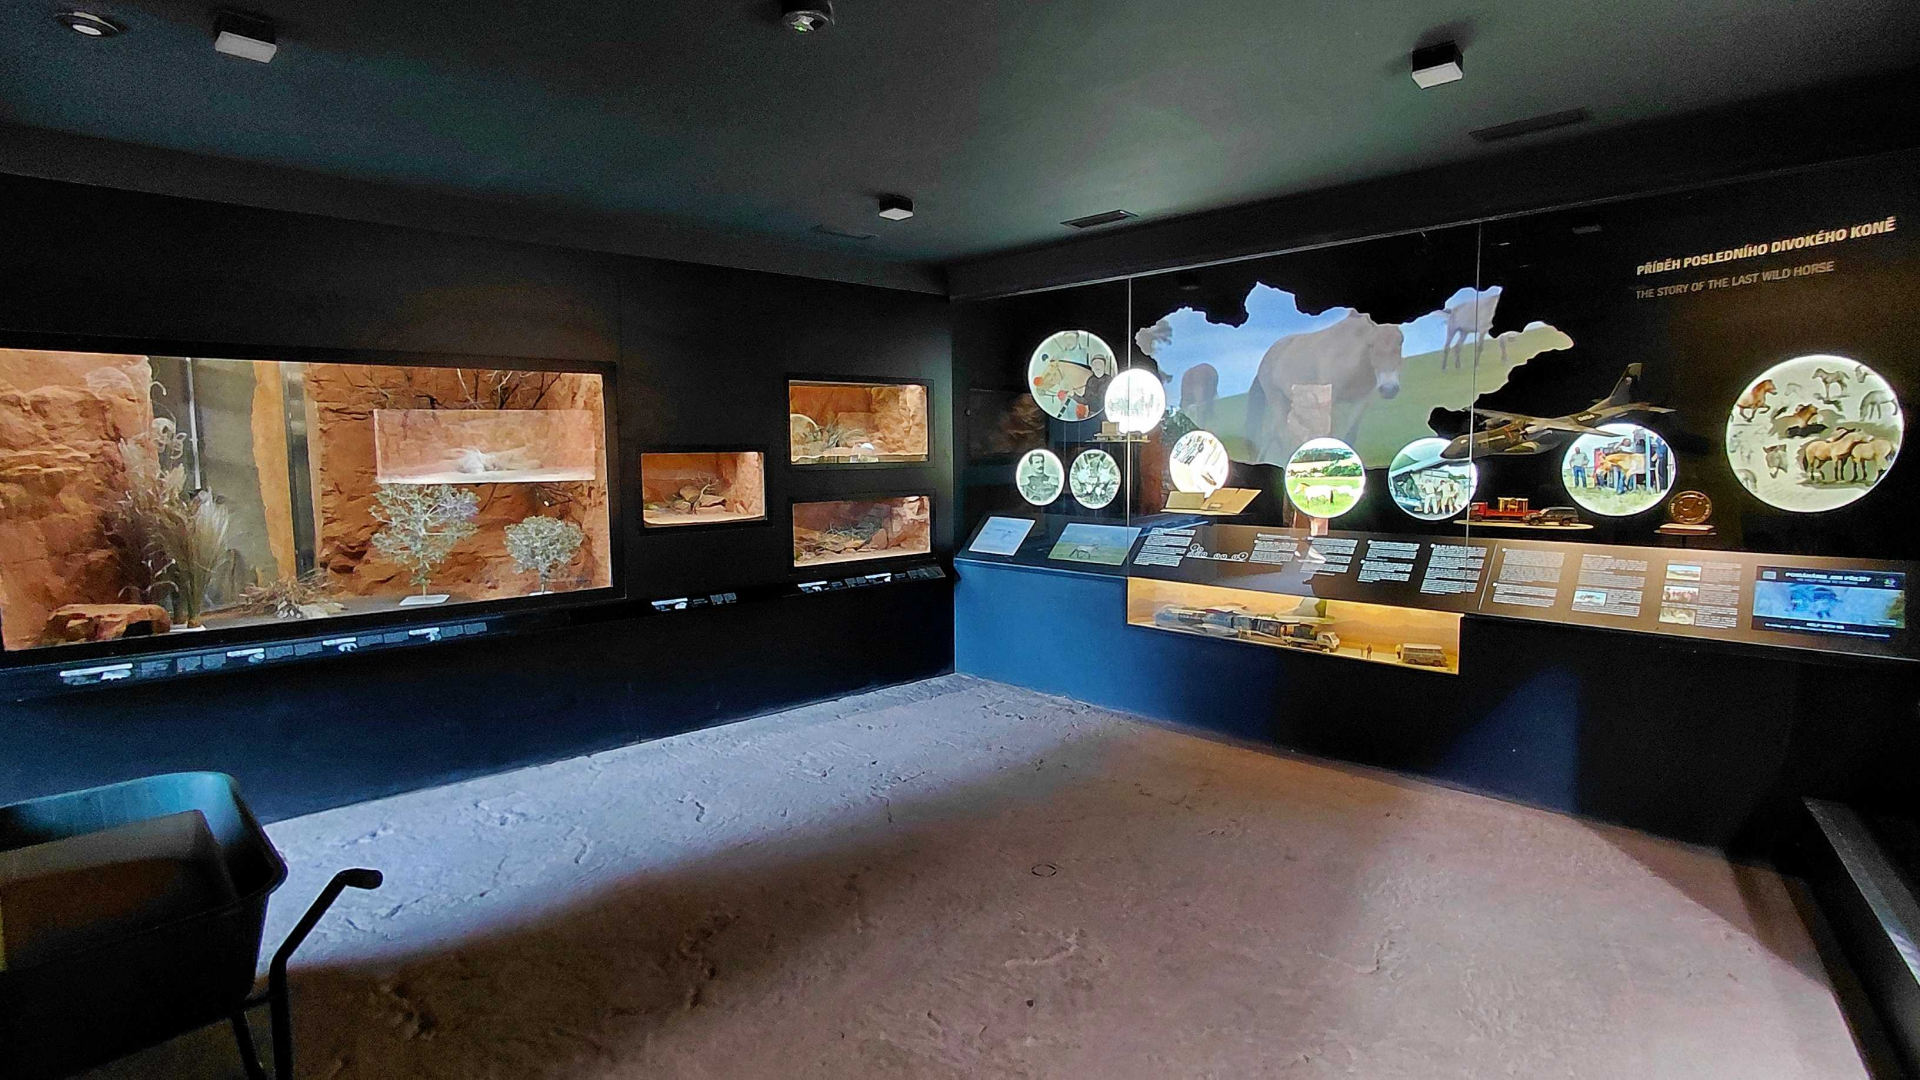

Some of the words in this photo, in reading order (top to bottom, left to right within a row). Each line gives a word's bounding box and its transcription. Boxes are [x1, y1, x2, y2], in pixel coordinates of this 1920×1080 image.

[1637, 258, 1681, 275] PŘÍBĚH
[1683, 244, 1768, 268] POSLEDNÍHO
[1771, 230, 1847, 253] DIVOKÉHO
[1850, 216, 1896, 239] KONĚ
[1636, 289, 1655, 299] THE
[1657, 284, 1688, 297] STORY
[1690, 281, 1705, 292] OF
[1708, 278, 1729, 289] THE
[1732, 273, 1760, 286] LAST
[1761, 269, 1791, 281] WILD
[1793, 261, 1835, 277] HORSE
